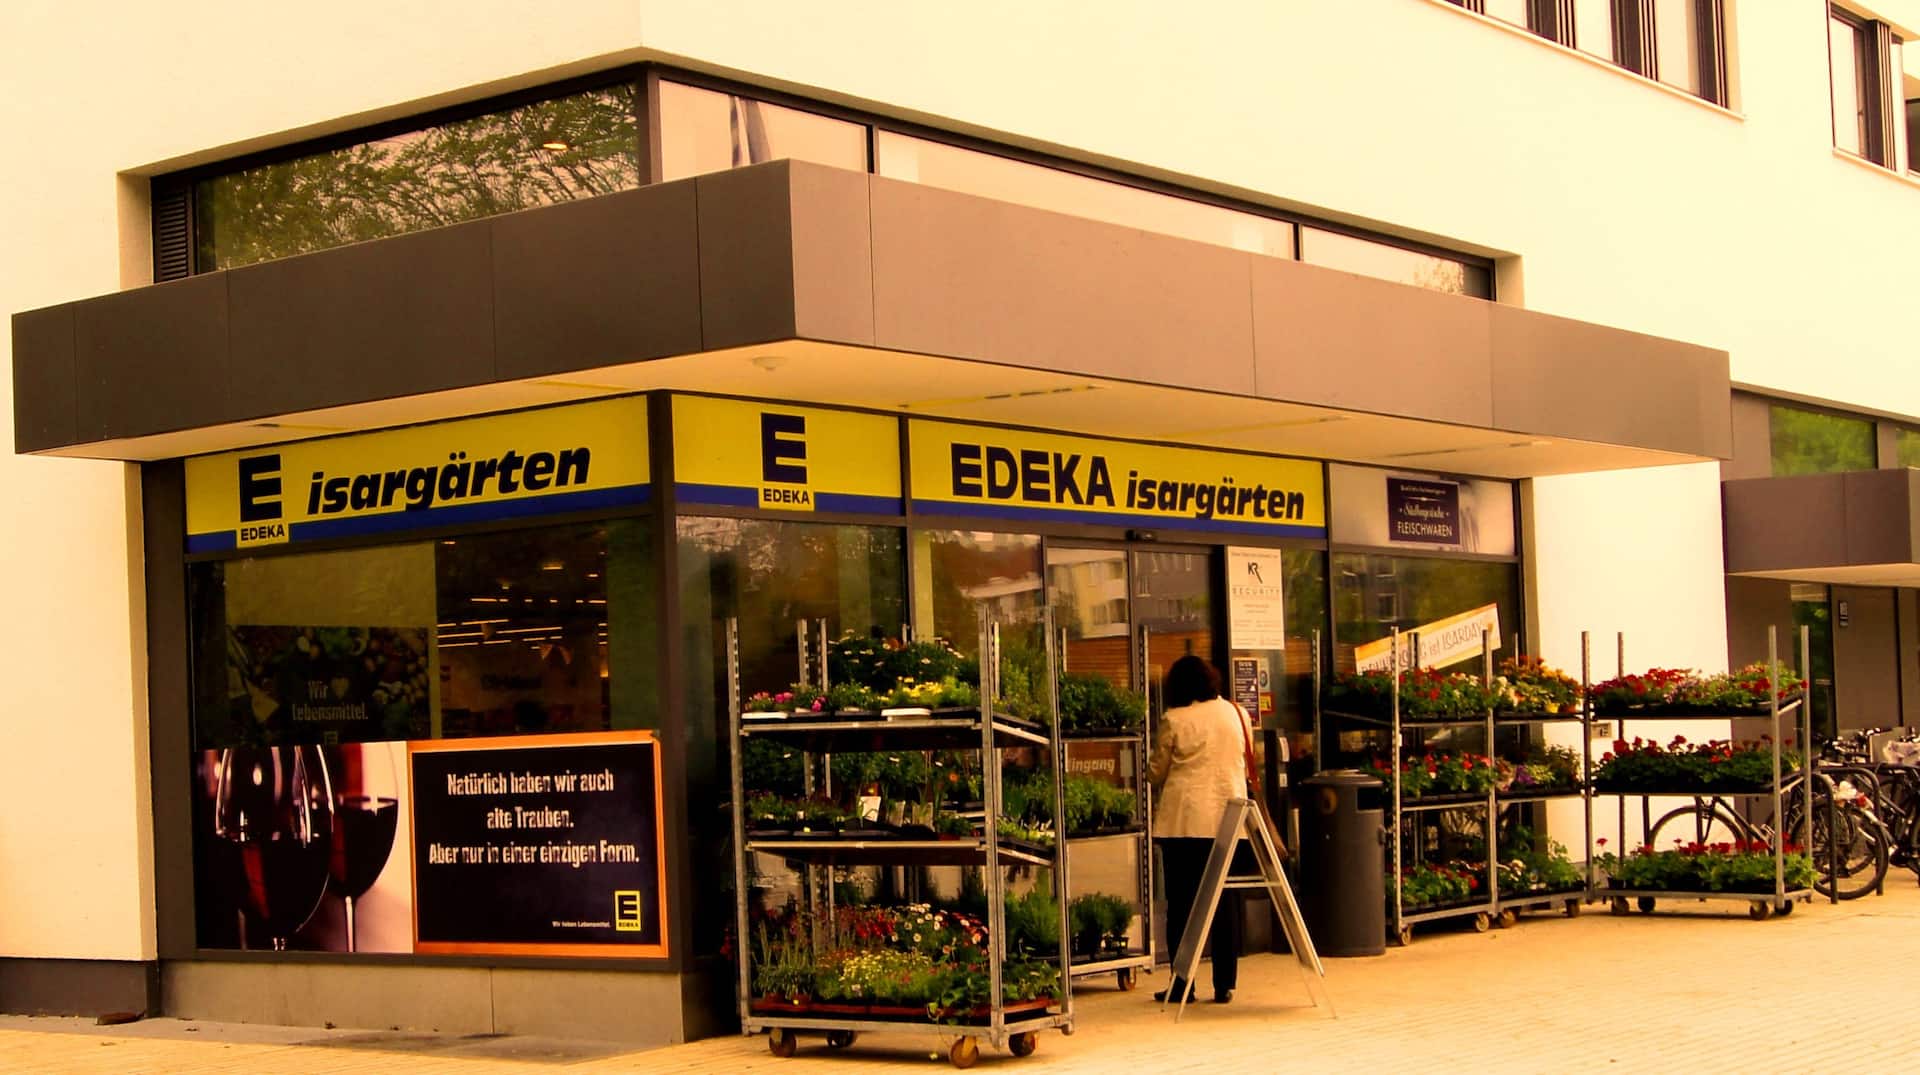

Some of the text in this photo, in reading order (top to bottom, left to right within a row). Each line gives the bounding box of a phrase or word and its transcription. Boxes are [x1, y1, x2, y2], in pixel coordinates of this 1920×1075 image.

[761, 412, 807, 484] E
[239, 447, 592, 522] E isargärten
[951, 443, 1305, 521] EDEKA isargärten
[763, 488, 810, 505] EDEKA
[240, 523, 285, 542] EDEKA
[1397, 521, 1453, 537] FLEISCHWAREN
[308, 680, 329, 700] Wir
[447, 768, 614, 796] Natürlich haben wir auch
[487, 806, 575, 829] alte Trauben.
[429, 839, 640, 868] Aber nur in einer einzigen Form.
